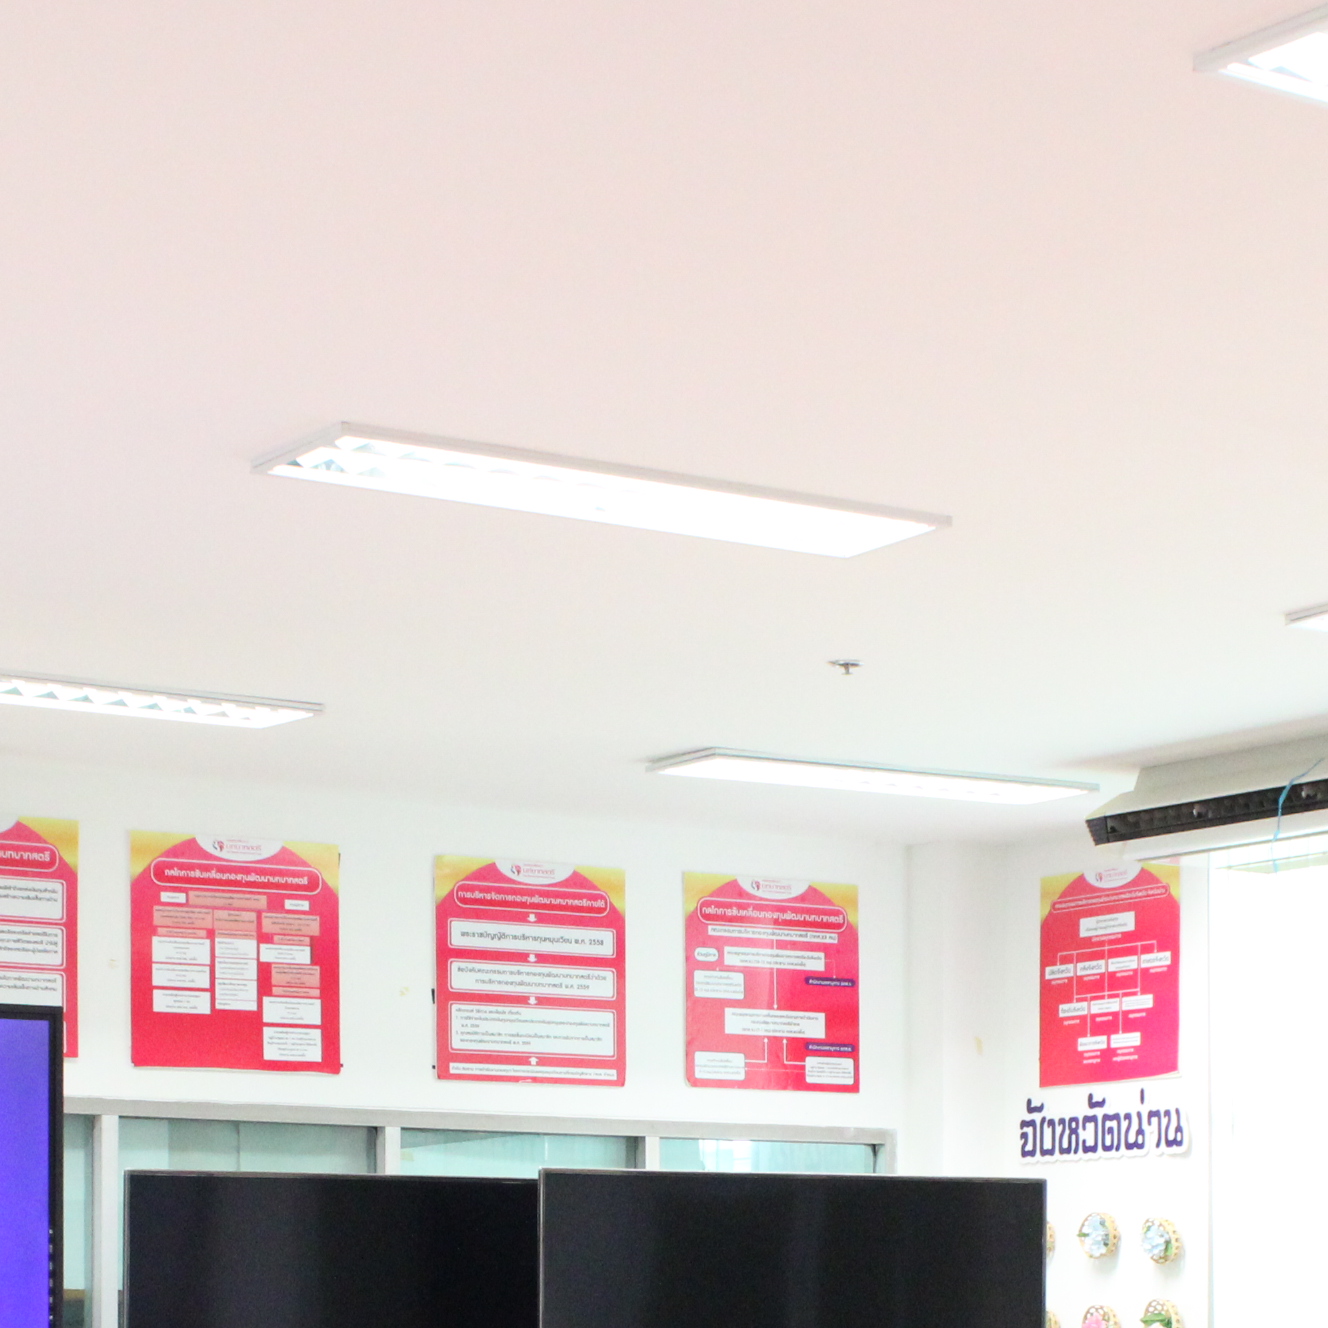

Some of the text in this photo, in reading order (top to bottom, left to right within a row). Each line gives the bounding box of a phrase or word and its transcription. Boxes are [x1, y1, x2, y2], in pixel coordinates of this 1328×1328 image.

[1019, 1087, 1184, 1158] จังหวัดน่าน
